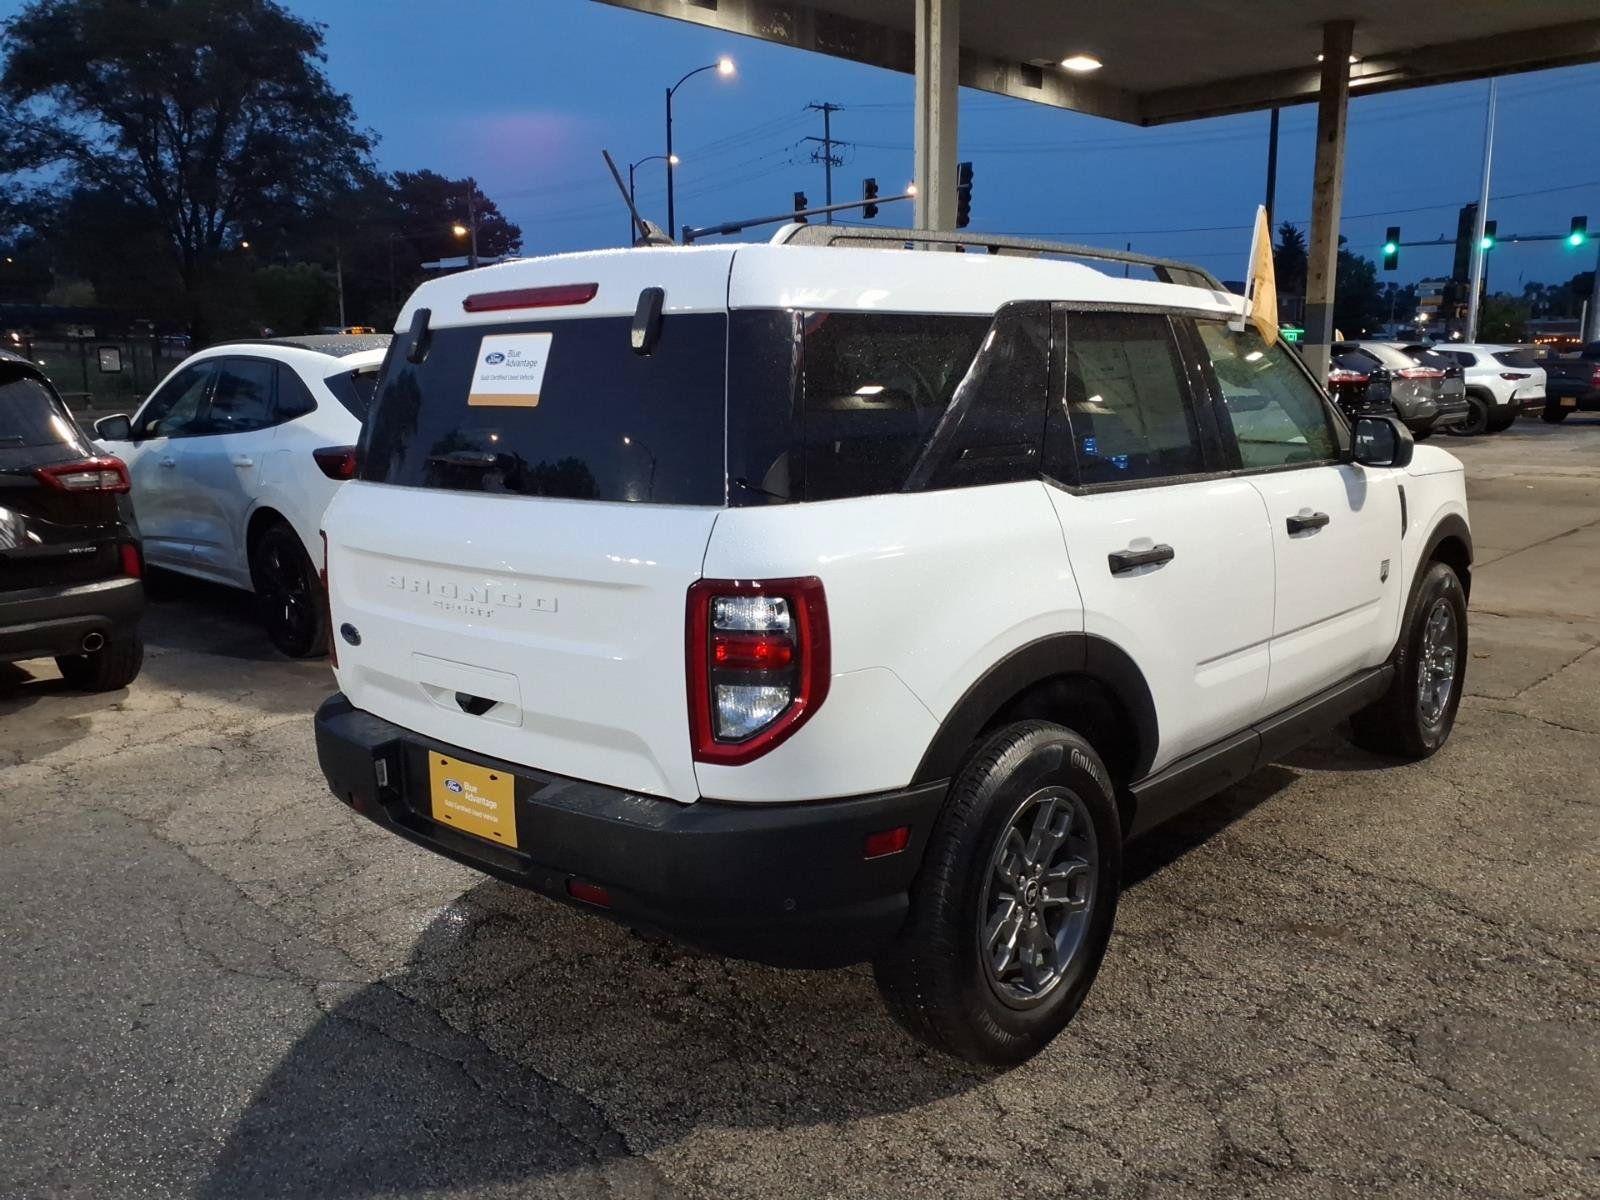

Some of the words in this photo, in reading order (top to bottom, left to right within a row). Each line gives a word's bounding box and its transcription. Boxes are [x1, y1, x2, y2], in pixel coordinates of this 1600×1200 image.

[507, 349, 522, 358] Blue
[505, 360, 538, 369] Advantage
[387, 575, 560, 614] BRONCO
[444, 779, 463, 793] Ford
[463, 781, 478, 793] Blue
[465, 792, 498, 810] Advantage
